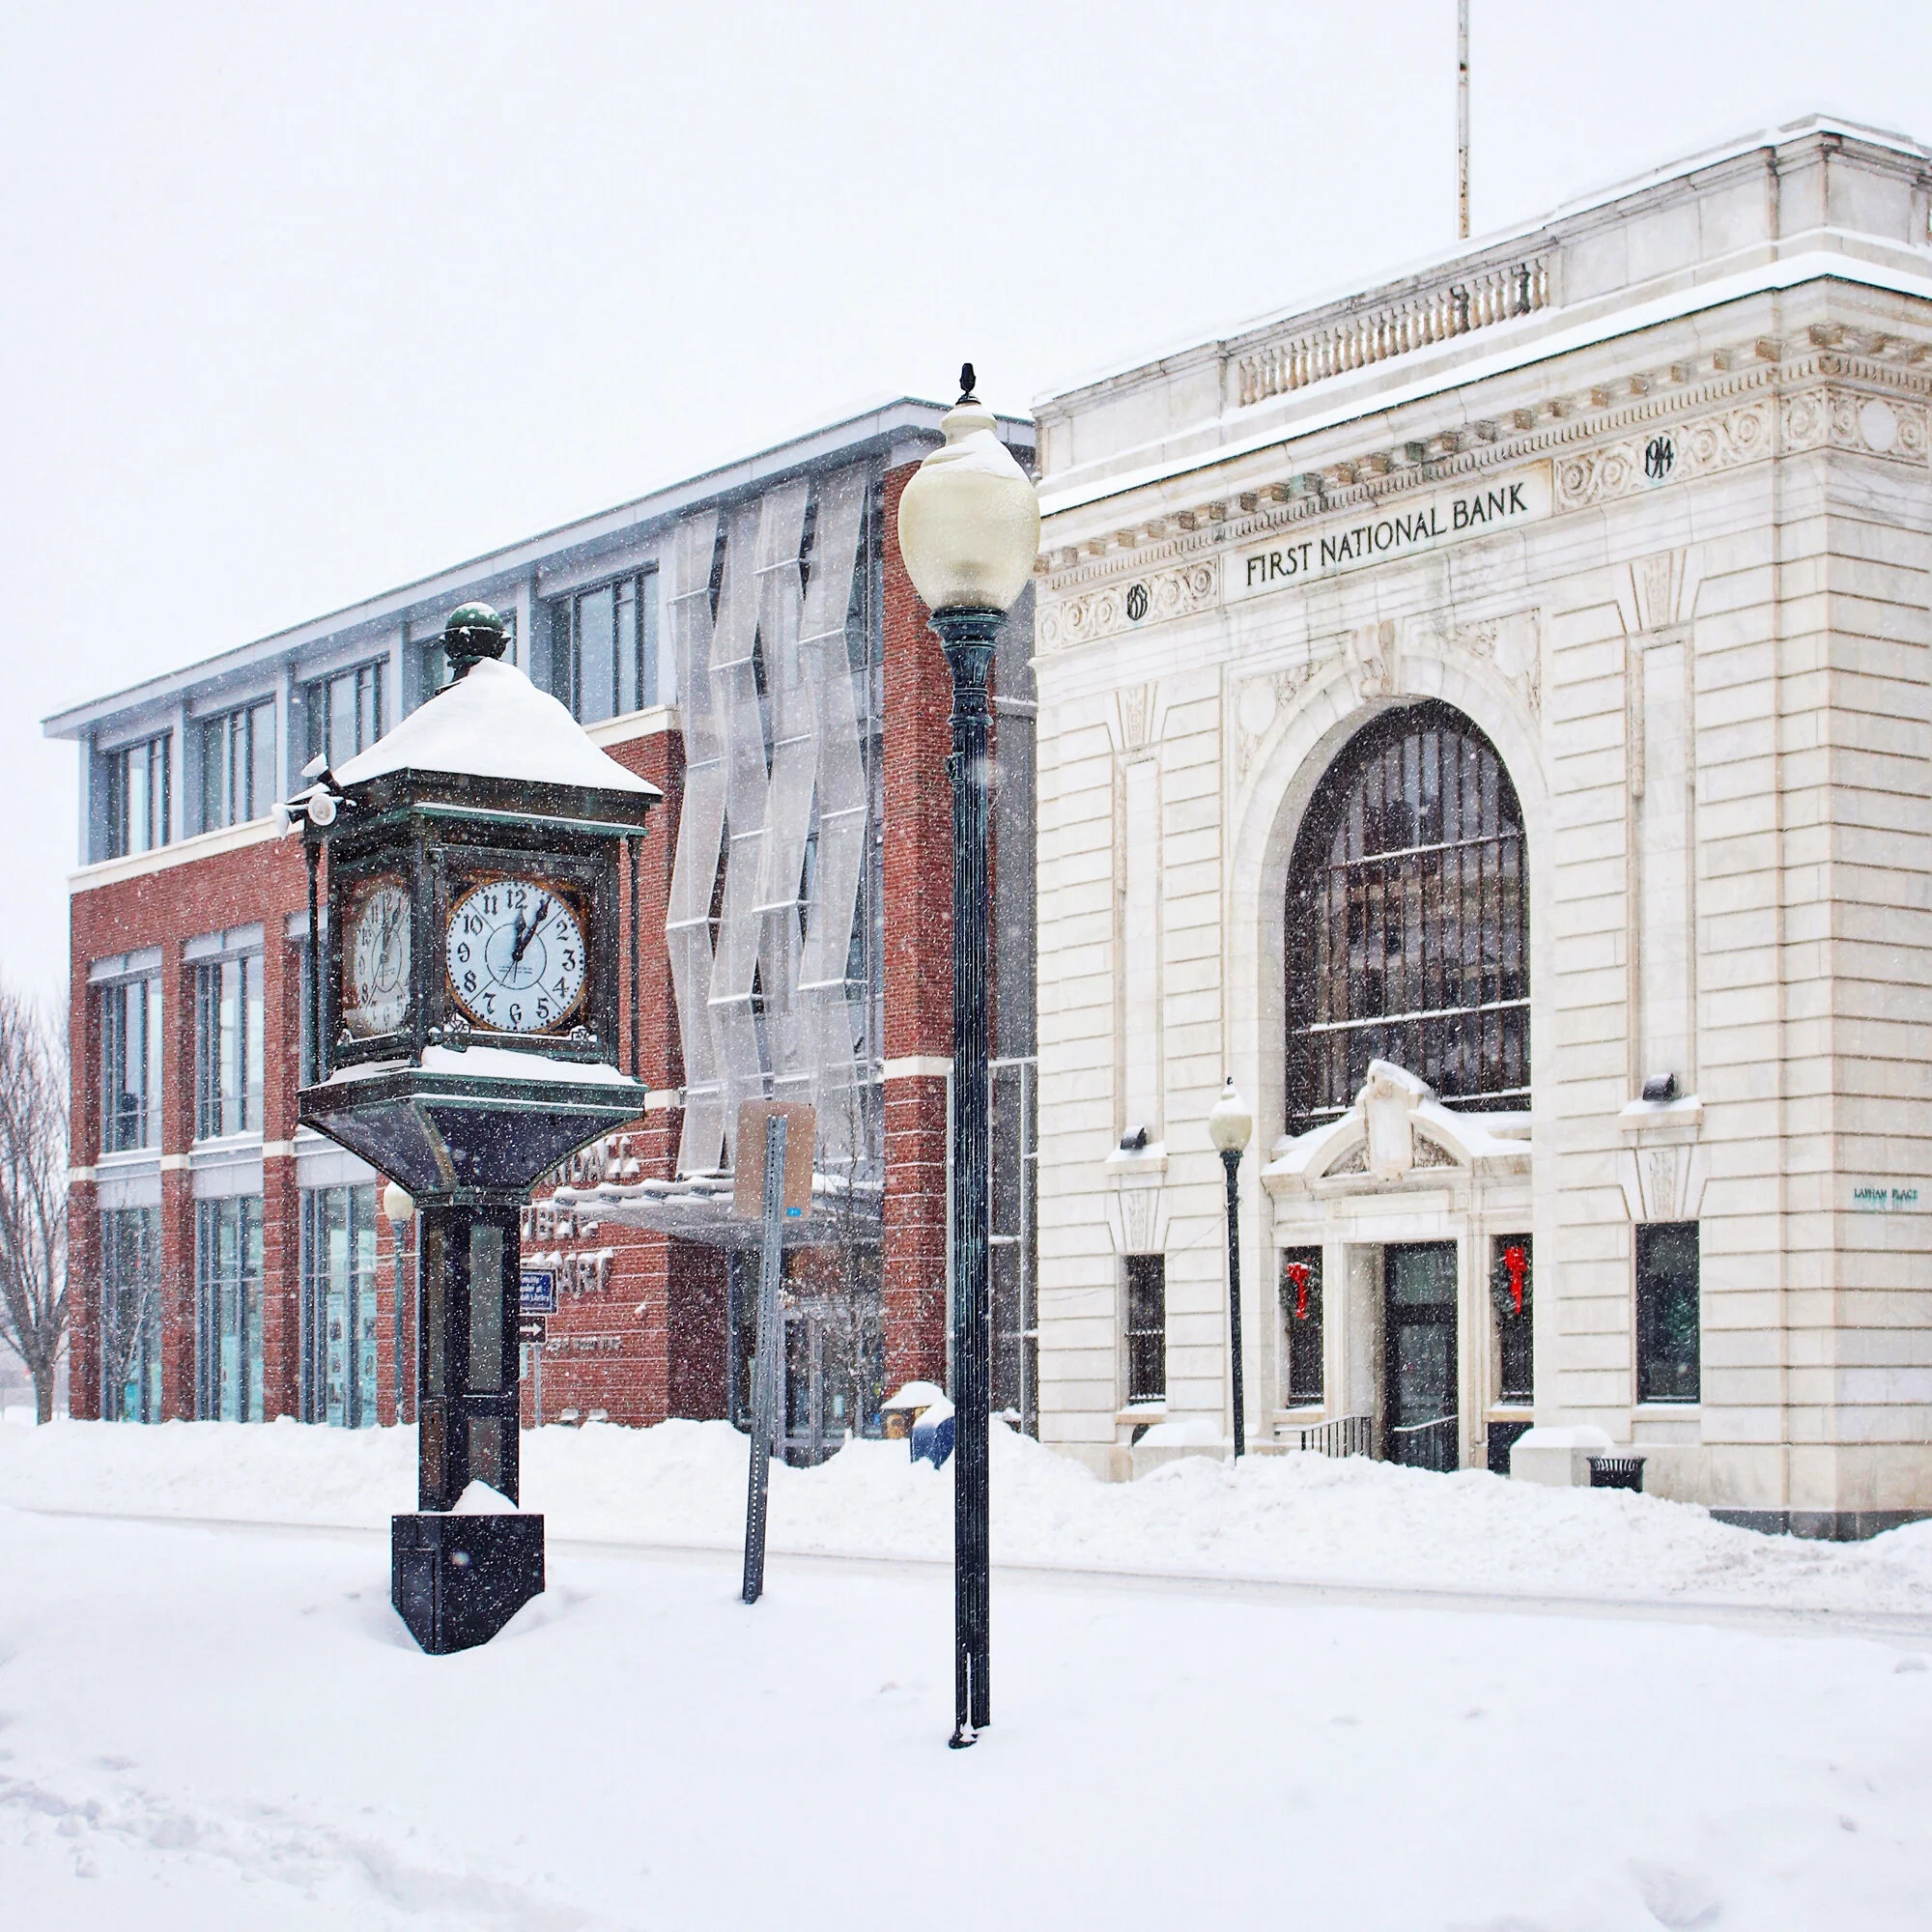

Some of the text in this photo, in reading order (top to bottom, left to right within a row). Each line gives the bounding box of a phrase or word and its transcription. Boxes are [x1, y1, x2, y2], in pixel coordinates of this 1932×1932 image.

[1246, 482, 1528, 586] FIRST NATIONAL BANK
[483, 895, 497, 916] 11
[506, 888, 528, 910] 12
[464, 913, 483, 935] 10
[555, 920, 570, 941] 2
[457, 942, 470, 963] 9
[561, 949, 576, 971] 3
[464, 970, 477, 993] 8
[553, 977, 570, 999] 4
[483, 992, 497, 1014] 7
[509, 1003, 522, 1025] 6
[535, 997, 550, 1019] 5
